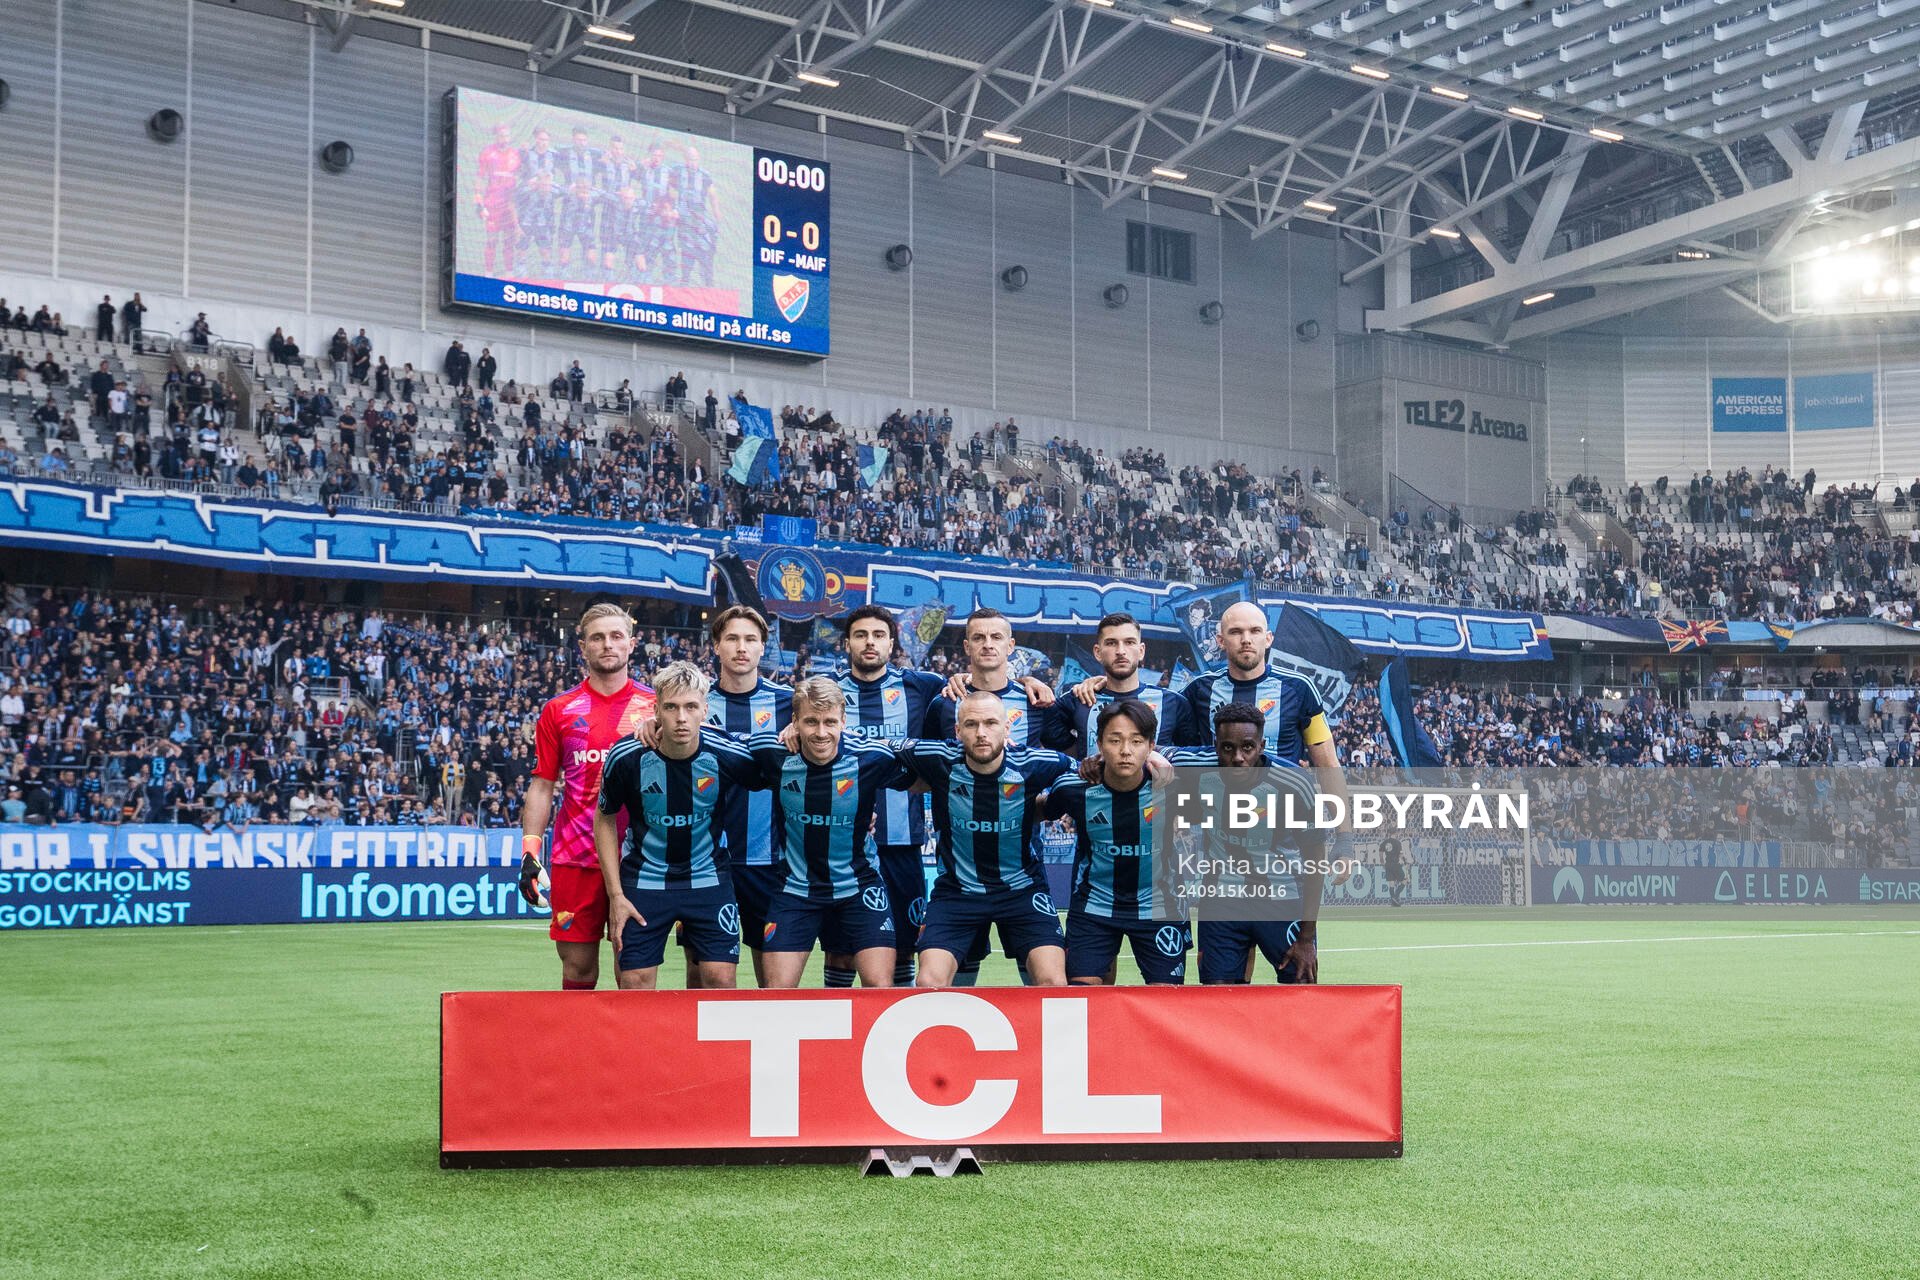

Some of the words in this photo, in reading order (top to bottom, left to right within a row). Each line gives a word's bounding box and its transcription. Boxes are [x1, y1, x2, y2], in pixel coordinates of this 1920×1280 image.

[758, 157, 825, 192] 00:00
[760, 247, 785, 264] DIF
[503, 285, 578, 312] Senaste
[583, 299, 619, 320] nytt
[622, 303, 668, 325] finns
[672, 311, 716, 333] alltid
[720, 317, 742, 338] på
[745, 321, 792, 344] dif.se
[1716, 395, 1783, 406] AMERICAN
[1725, 405, 1784, 415] EXPRESS
[1404, 399, 1466, 432] TELE2
[1468, 410, 1528, 441] Arena
[1464, 616, 1537, 653] IF
[647, 810, 713, 827] MOBILL
[784, 809, 852, 826] MOBILL
[952, 817, 1020, 833] MOBILL
[0, 871, 191, 894] STOCKHOLMS
[1322, 865, 1446, 899] MOBLL
[1594, 874, 1676, 898] NordVPN
[1745, 873, 1829, 898] ELEDA
[0, 893, 191, 927] GOLVTJÄNST
[696, 991, 1163, 1141] TCL
